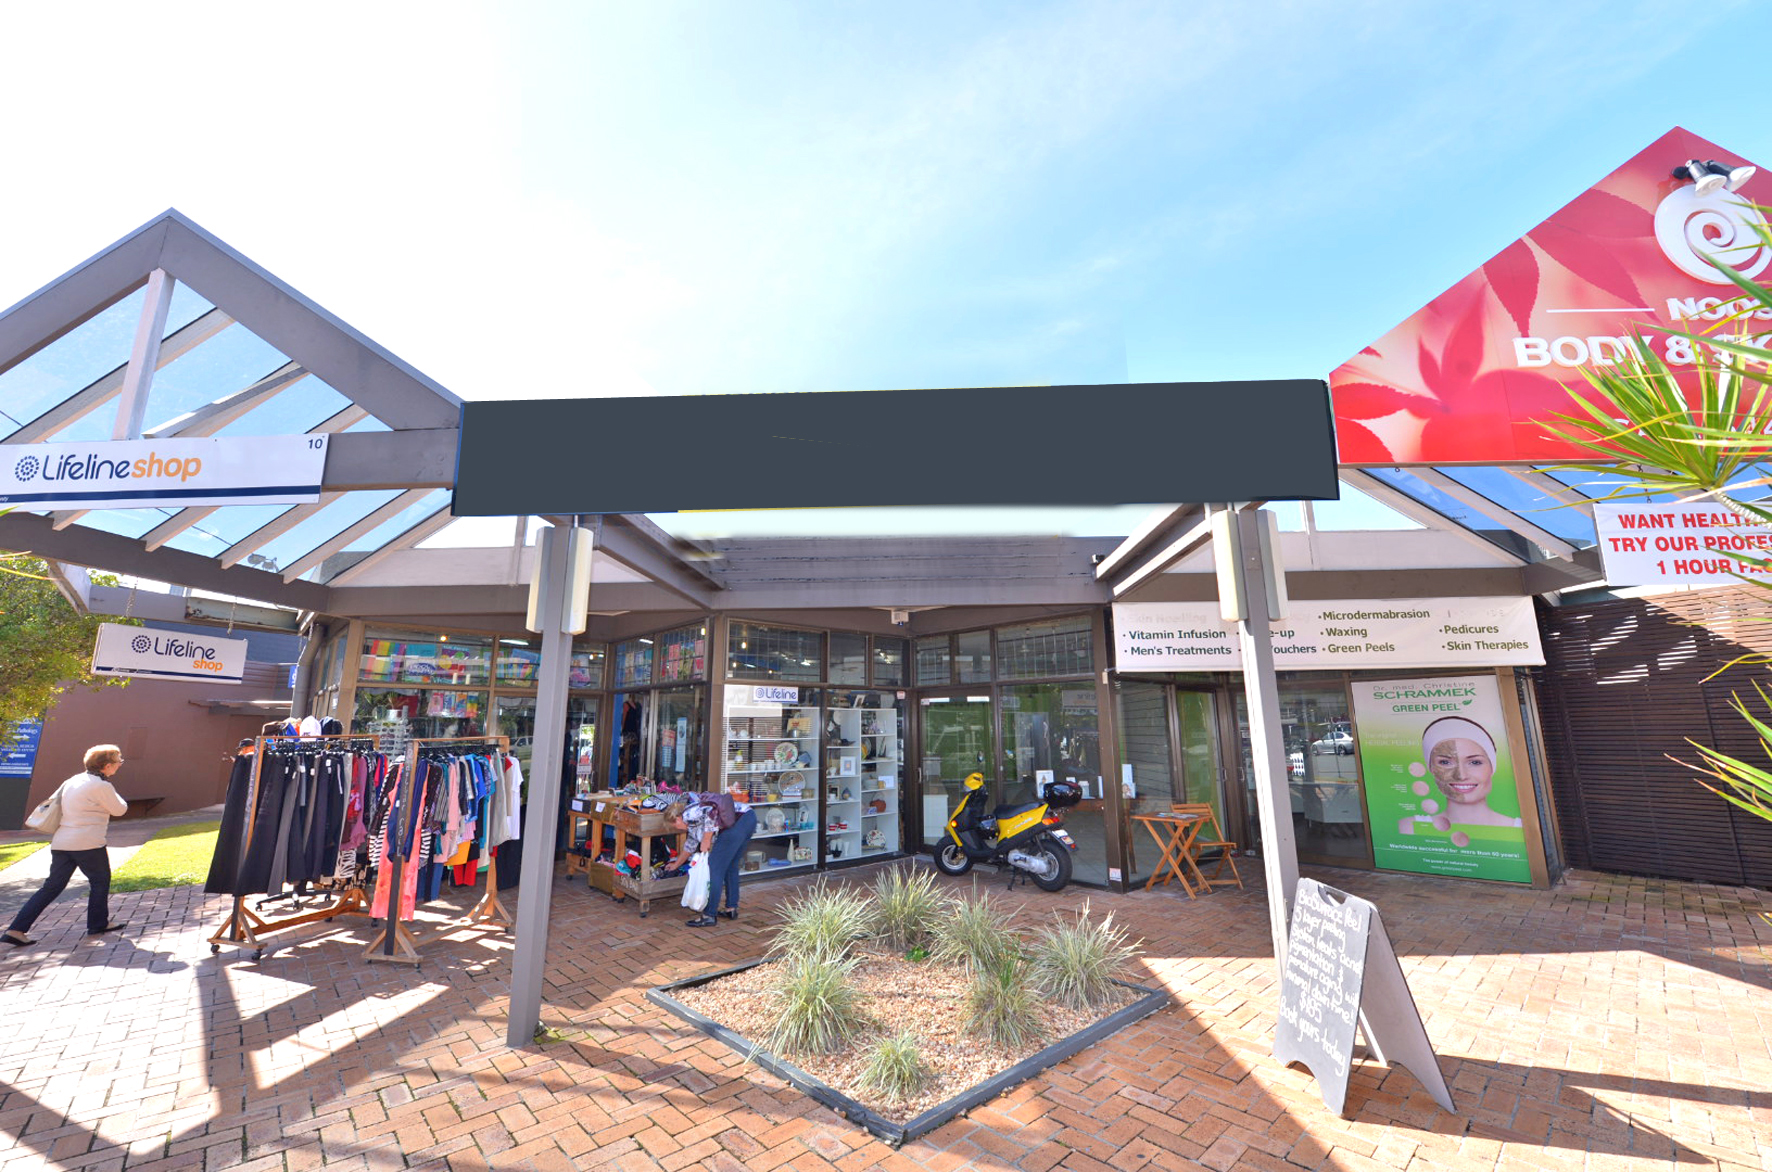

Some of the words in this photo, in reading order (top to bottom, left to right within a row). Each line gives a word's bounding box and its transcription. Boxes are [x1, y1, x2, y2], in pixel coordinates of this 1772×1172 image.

[1512, 335, 1654, 368] BODY
[1665, 335, 1702, 365] &
[308, 438, 323, 450] 10
[1618, 513, 1675, 529] WANT
[1608, 537, 1648, 552] TRY
[1655, 536, 1698, 551] OUR
[1704, 534, 1772, 551] PROFE
[1657, 561, 1667, 574] 1
[1674, 559, 1733, 575] HOUR
[1323, 609, 1430, 621] Microdermabrasion
[1129, 630, 1173, 640] Vitamin
[1178, 629, 1227, 639] Infusion
[1325, 627, 1368, 638] Waxing
[1444, 624, 1499, 635] Pedicures
[154, 636, 216, 660] Lifeline
[1131, 645, 1163, 655] Men's
[1165, 645, 1232, 655] Treatments
[1271, 644, 1317, 654] ouchers
[1328, 644, 1362, 653] Green
[1365, 642, 1395, 652] Peels
[1447, 641, 1472, 651] Skin
[1474, 639, 1529, 652] Therapies
[193, 659, 224, 673] shop
[765, 687, 797, 699] Lifeline
[1373, 687, 1477, 700] SCHRAMMEK
[1392, 704, 1429, 712] GREEN
[1432, 703, 1461, 712] PEEL
[1294, 905, 1303, 922] 5
[1302, 908, 1321, 933] layer
[1280, 995, 1298, 1028] Book
[1297, 1017, 1320, 1043] yours
[1321, 1027, 1346, 1077] today
